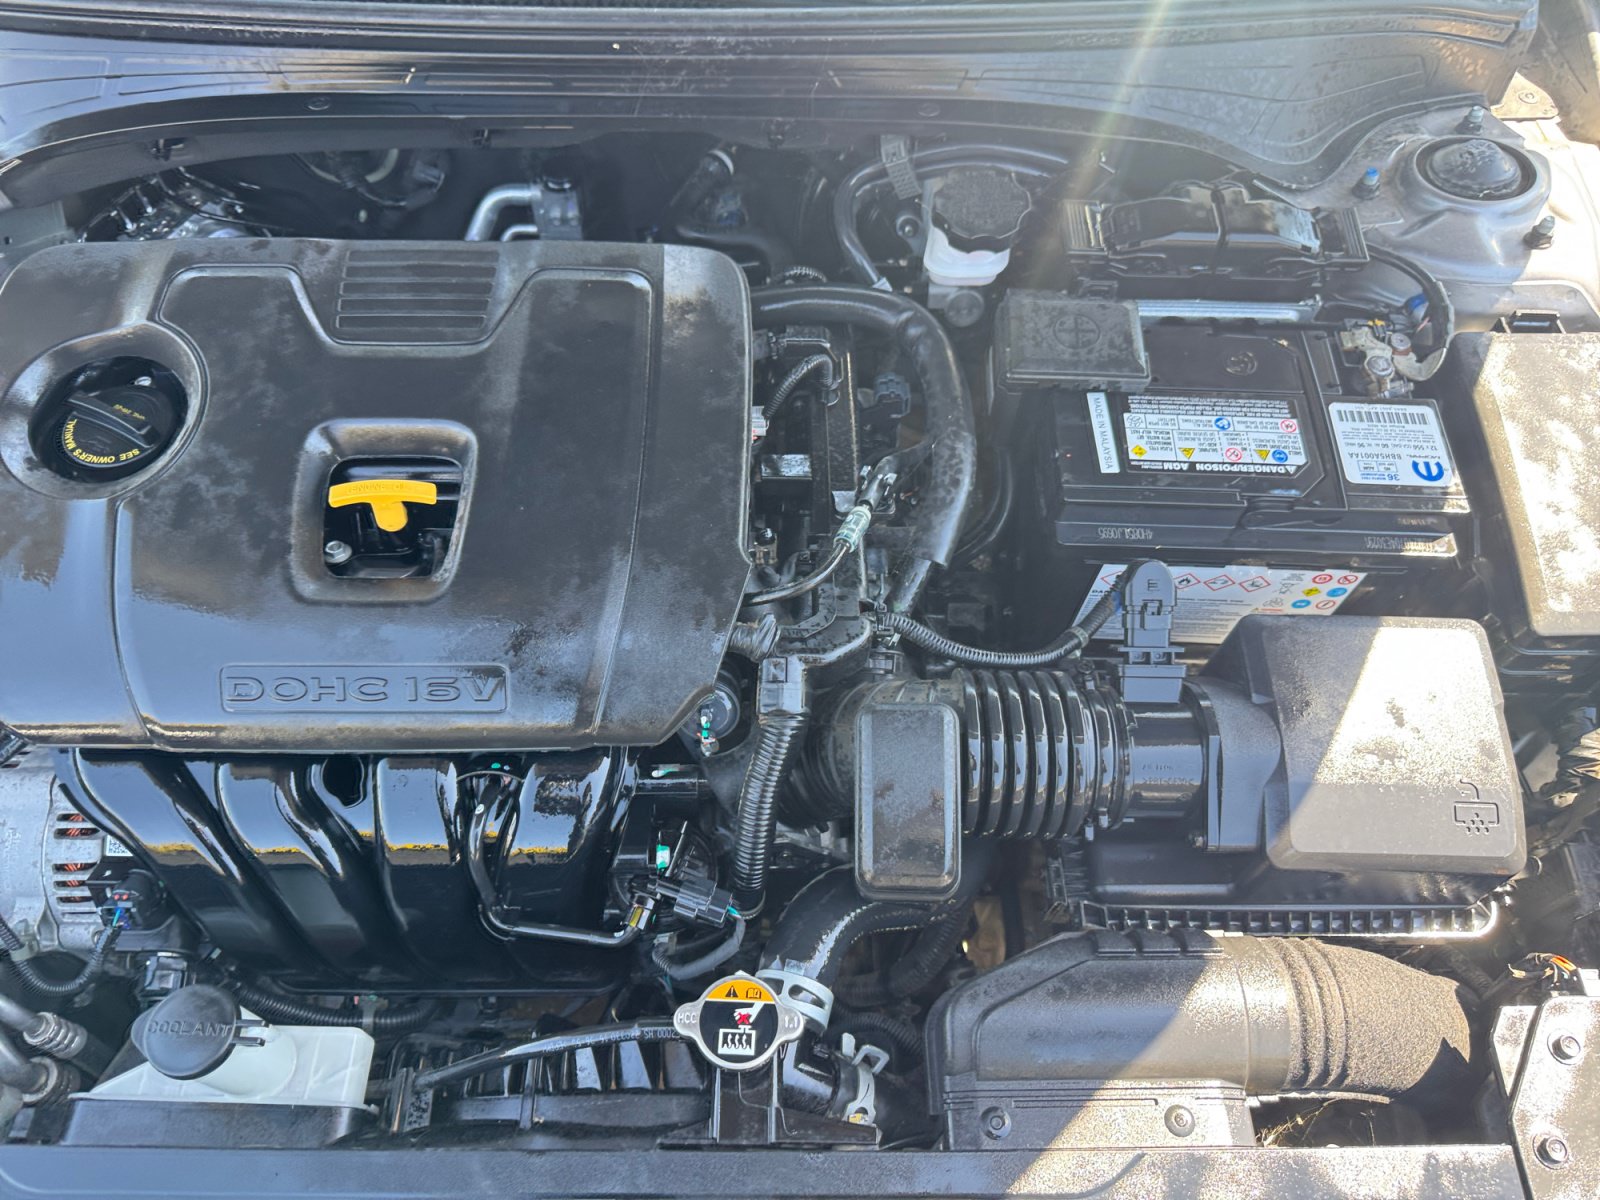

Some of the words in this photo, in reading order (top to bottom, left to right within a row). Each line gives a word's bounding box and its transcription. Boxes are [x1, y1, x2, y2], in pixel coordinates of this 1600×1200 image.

[65, 418, 78, 450] MANUAL
[1094, 397, 1104, 419] MADE
[1099, 431, 1113, 469] MALAYSIA
[73, 449, 115, 464] OWNER'S
[119, 448, 140, 461] SEE
[1163, 462, 1189, 471] AGM
[1196, 463, 1285, 473] DANGER/POISON
[225, 676, 389, 702] DOHC
[404, 676, 506, 702] 16V
[677, 1012, 697, 1024] HCC
[147, 1020, 233, 1037] COOLANT
